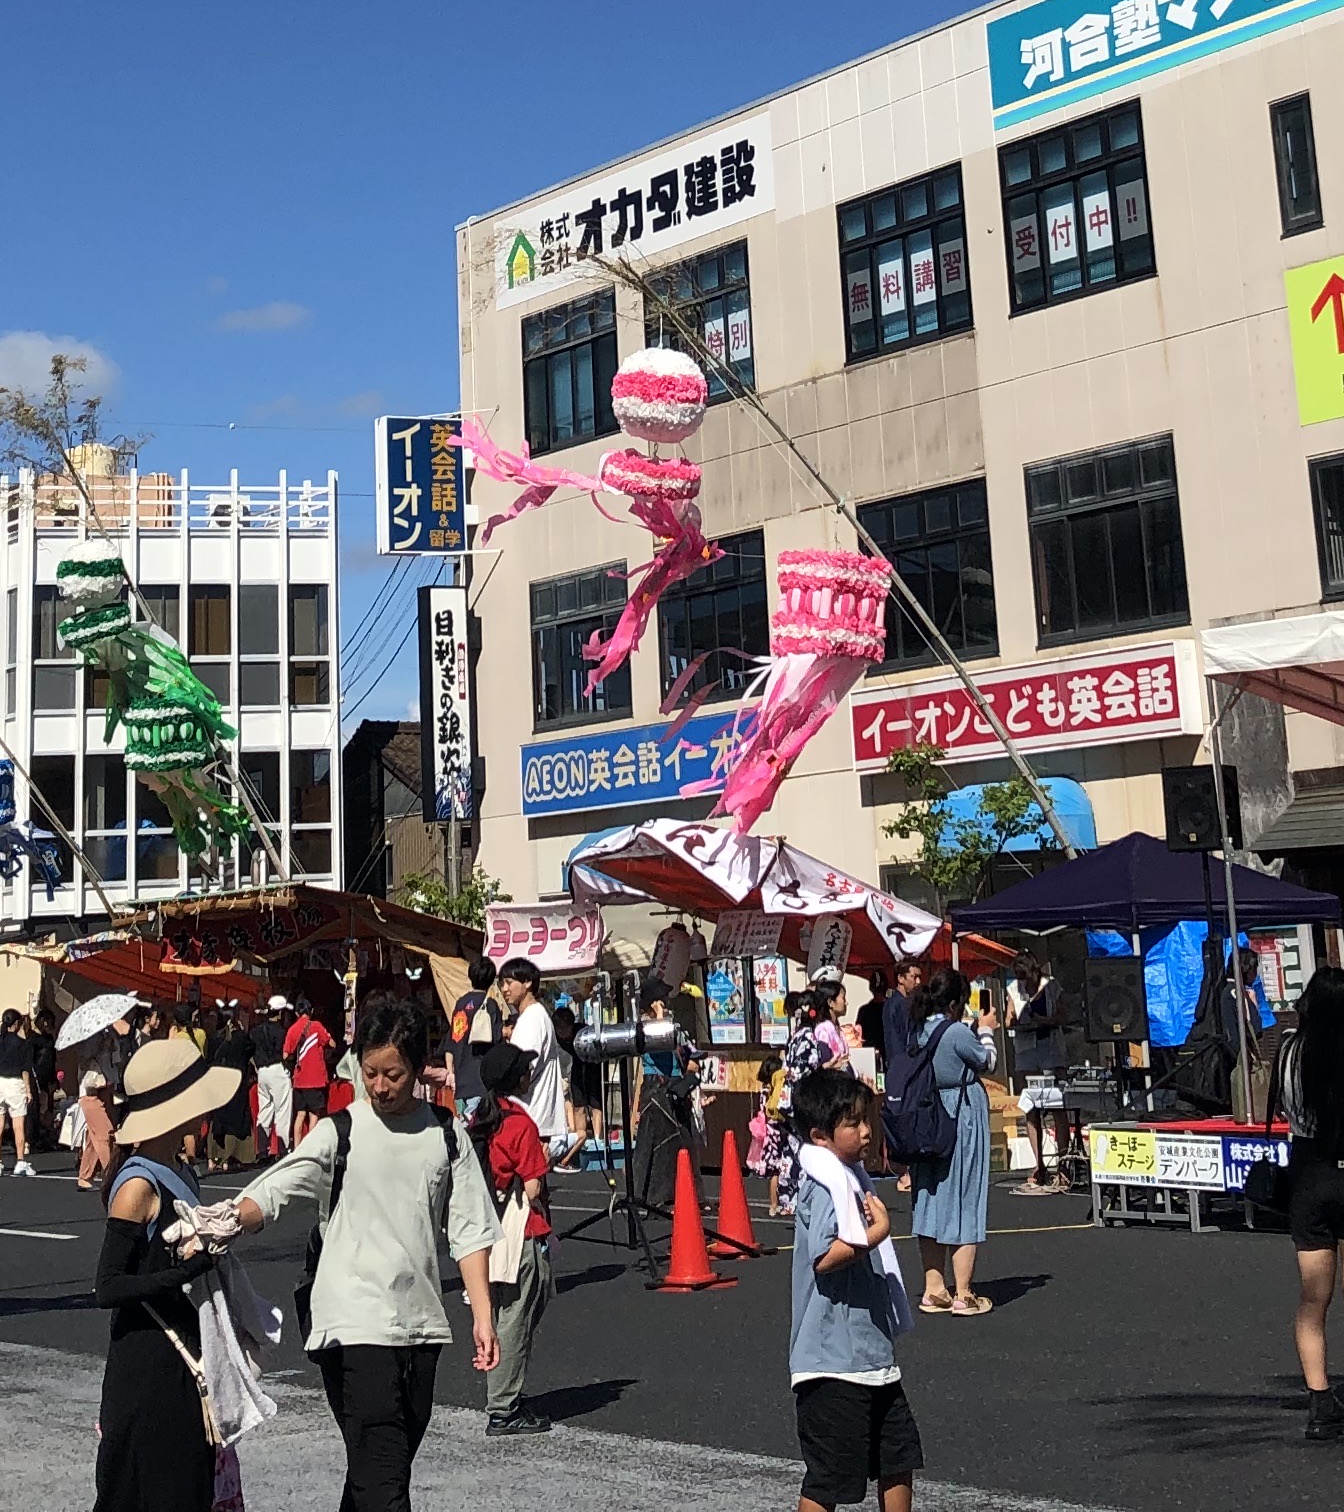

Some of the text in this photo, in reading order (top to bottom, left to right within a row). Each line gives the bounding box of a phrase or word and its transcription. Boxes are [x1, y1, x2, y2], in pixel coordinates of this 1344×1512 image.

[540, 212, 570, 248] 株式
[541, 242, 572, 276] 会社
[707, 319, 748, 359] 特別
[850, 248, 962, 314] 無料講習
[392, 422, 422, 550] イーオン
[435, 609, 462, 776] 目利きの銀次
[862, 664, 1173, 753] イーオンこども英会話
[1109, 1135, 1146, 1152] きーほー
[1159, 1144, 1219, 1159] 安城産業文化公園
[1117, 1153, 1155, 1170] ステージ
[1159, 1158, 1220, 1180] デンパーク
